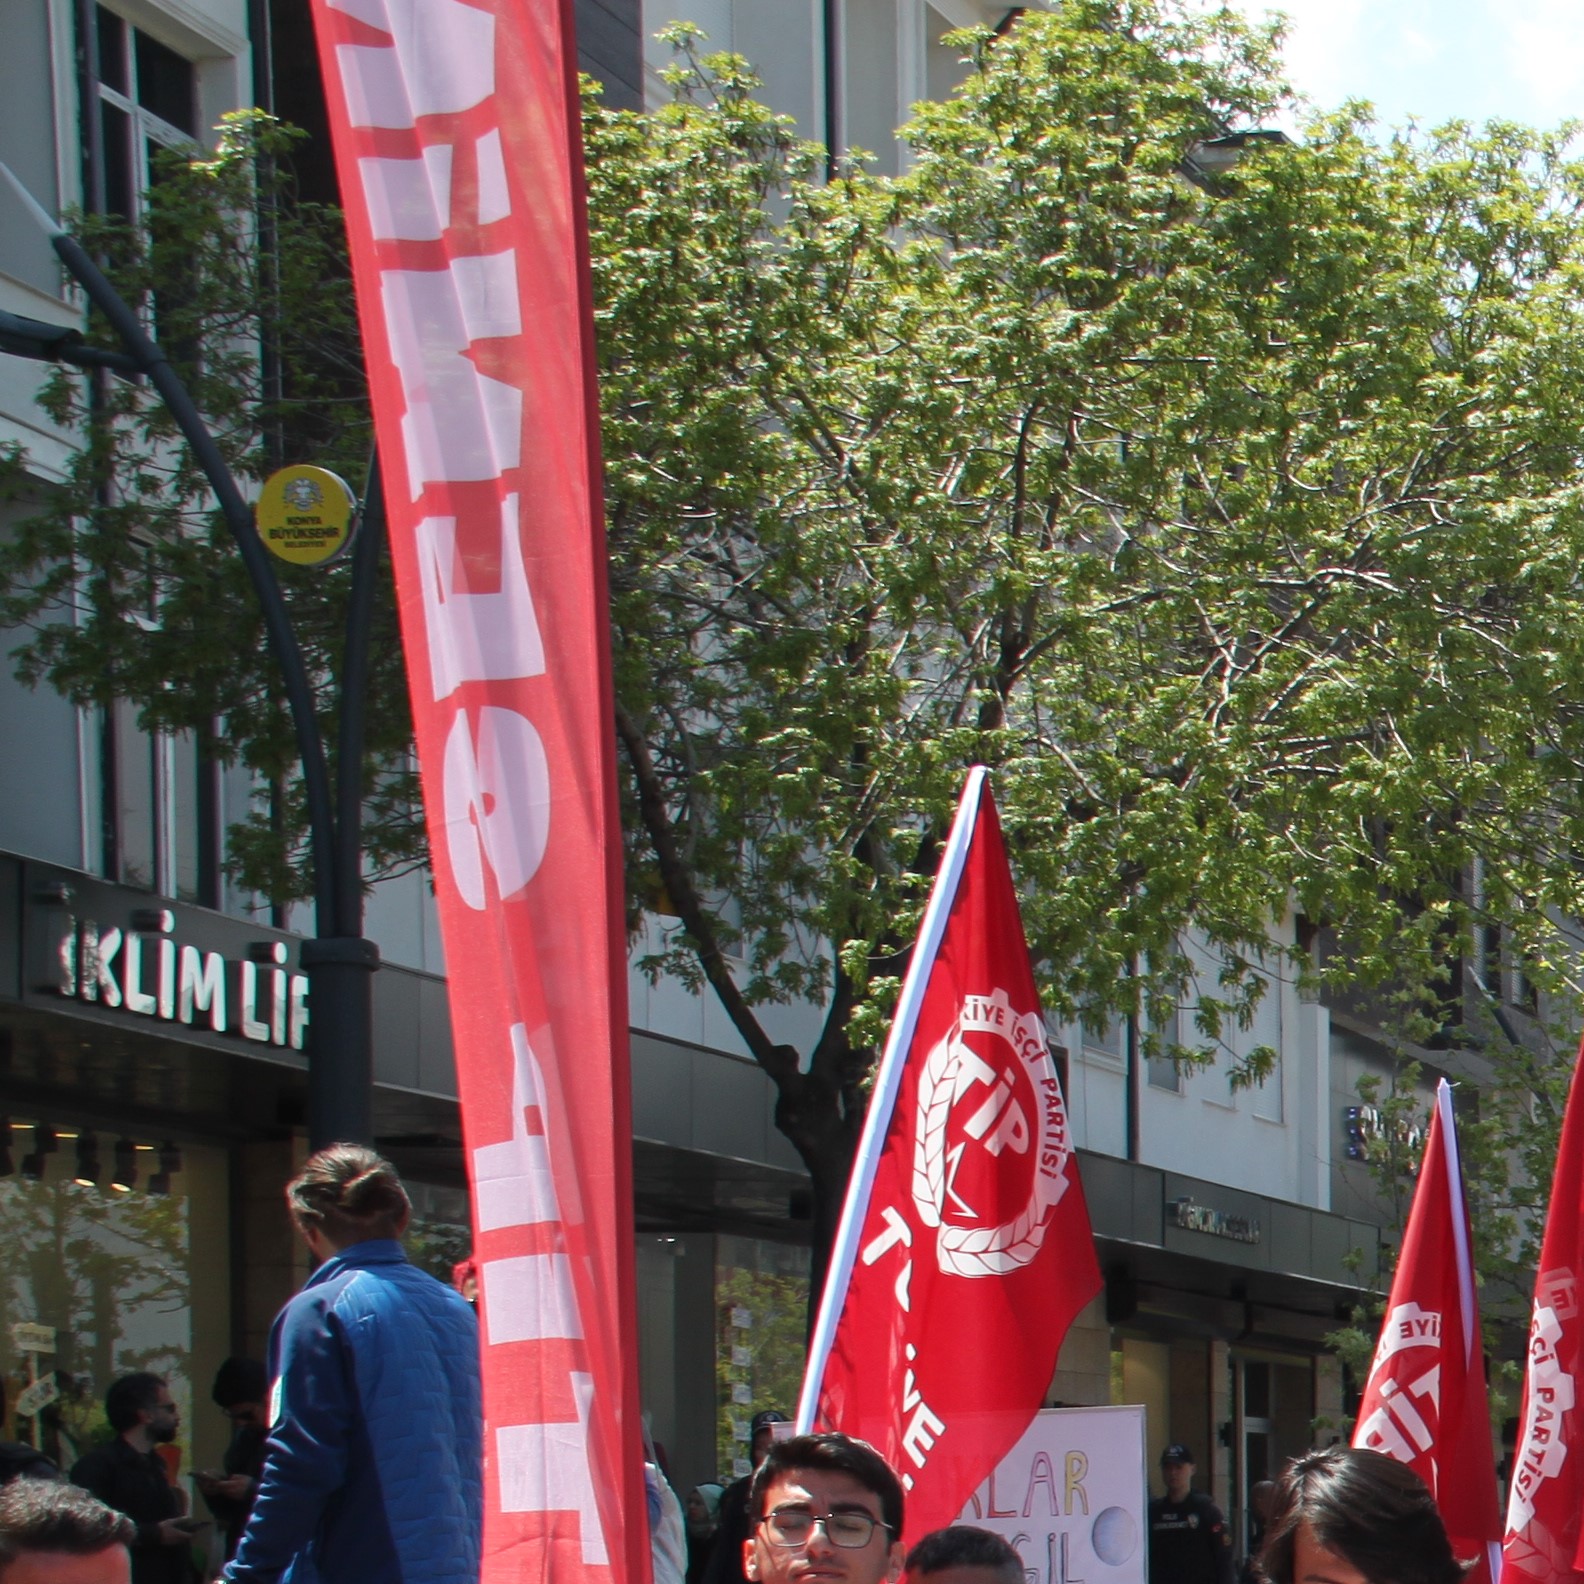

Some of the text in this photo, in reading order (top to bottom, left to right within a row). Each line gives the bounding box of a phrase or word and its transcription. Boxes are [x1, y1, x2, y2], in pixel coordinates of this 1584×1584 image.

[951, 1042, 1030, 1157] TİP
[1010, 1016, 1049, 1064] İŞÇİ
[1040, 1077, 1066, 1180] PARTİSİ
[1511, 1386, 1555, 1503] PARTİSİ
